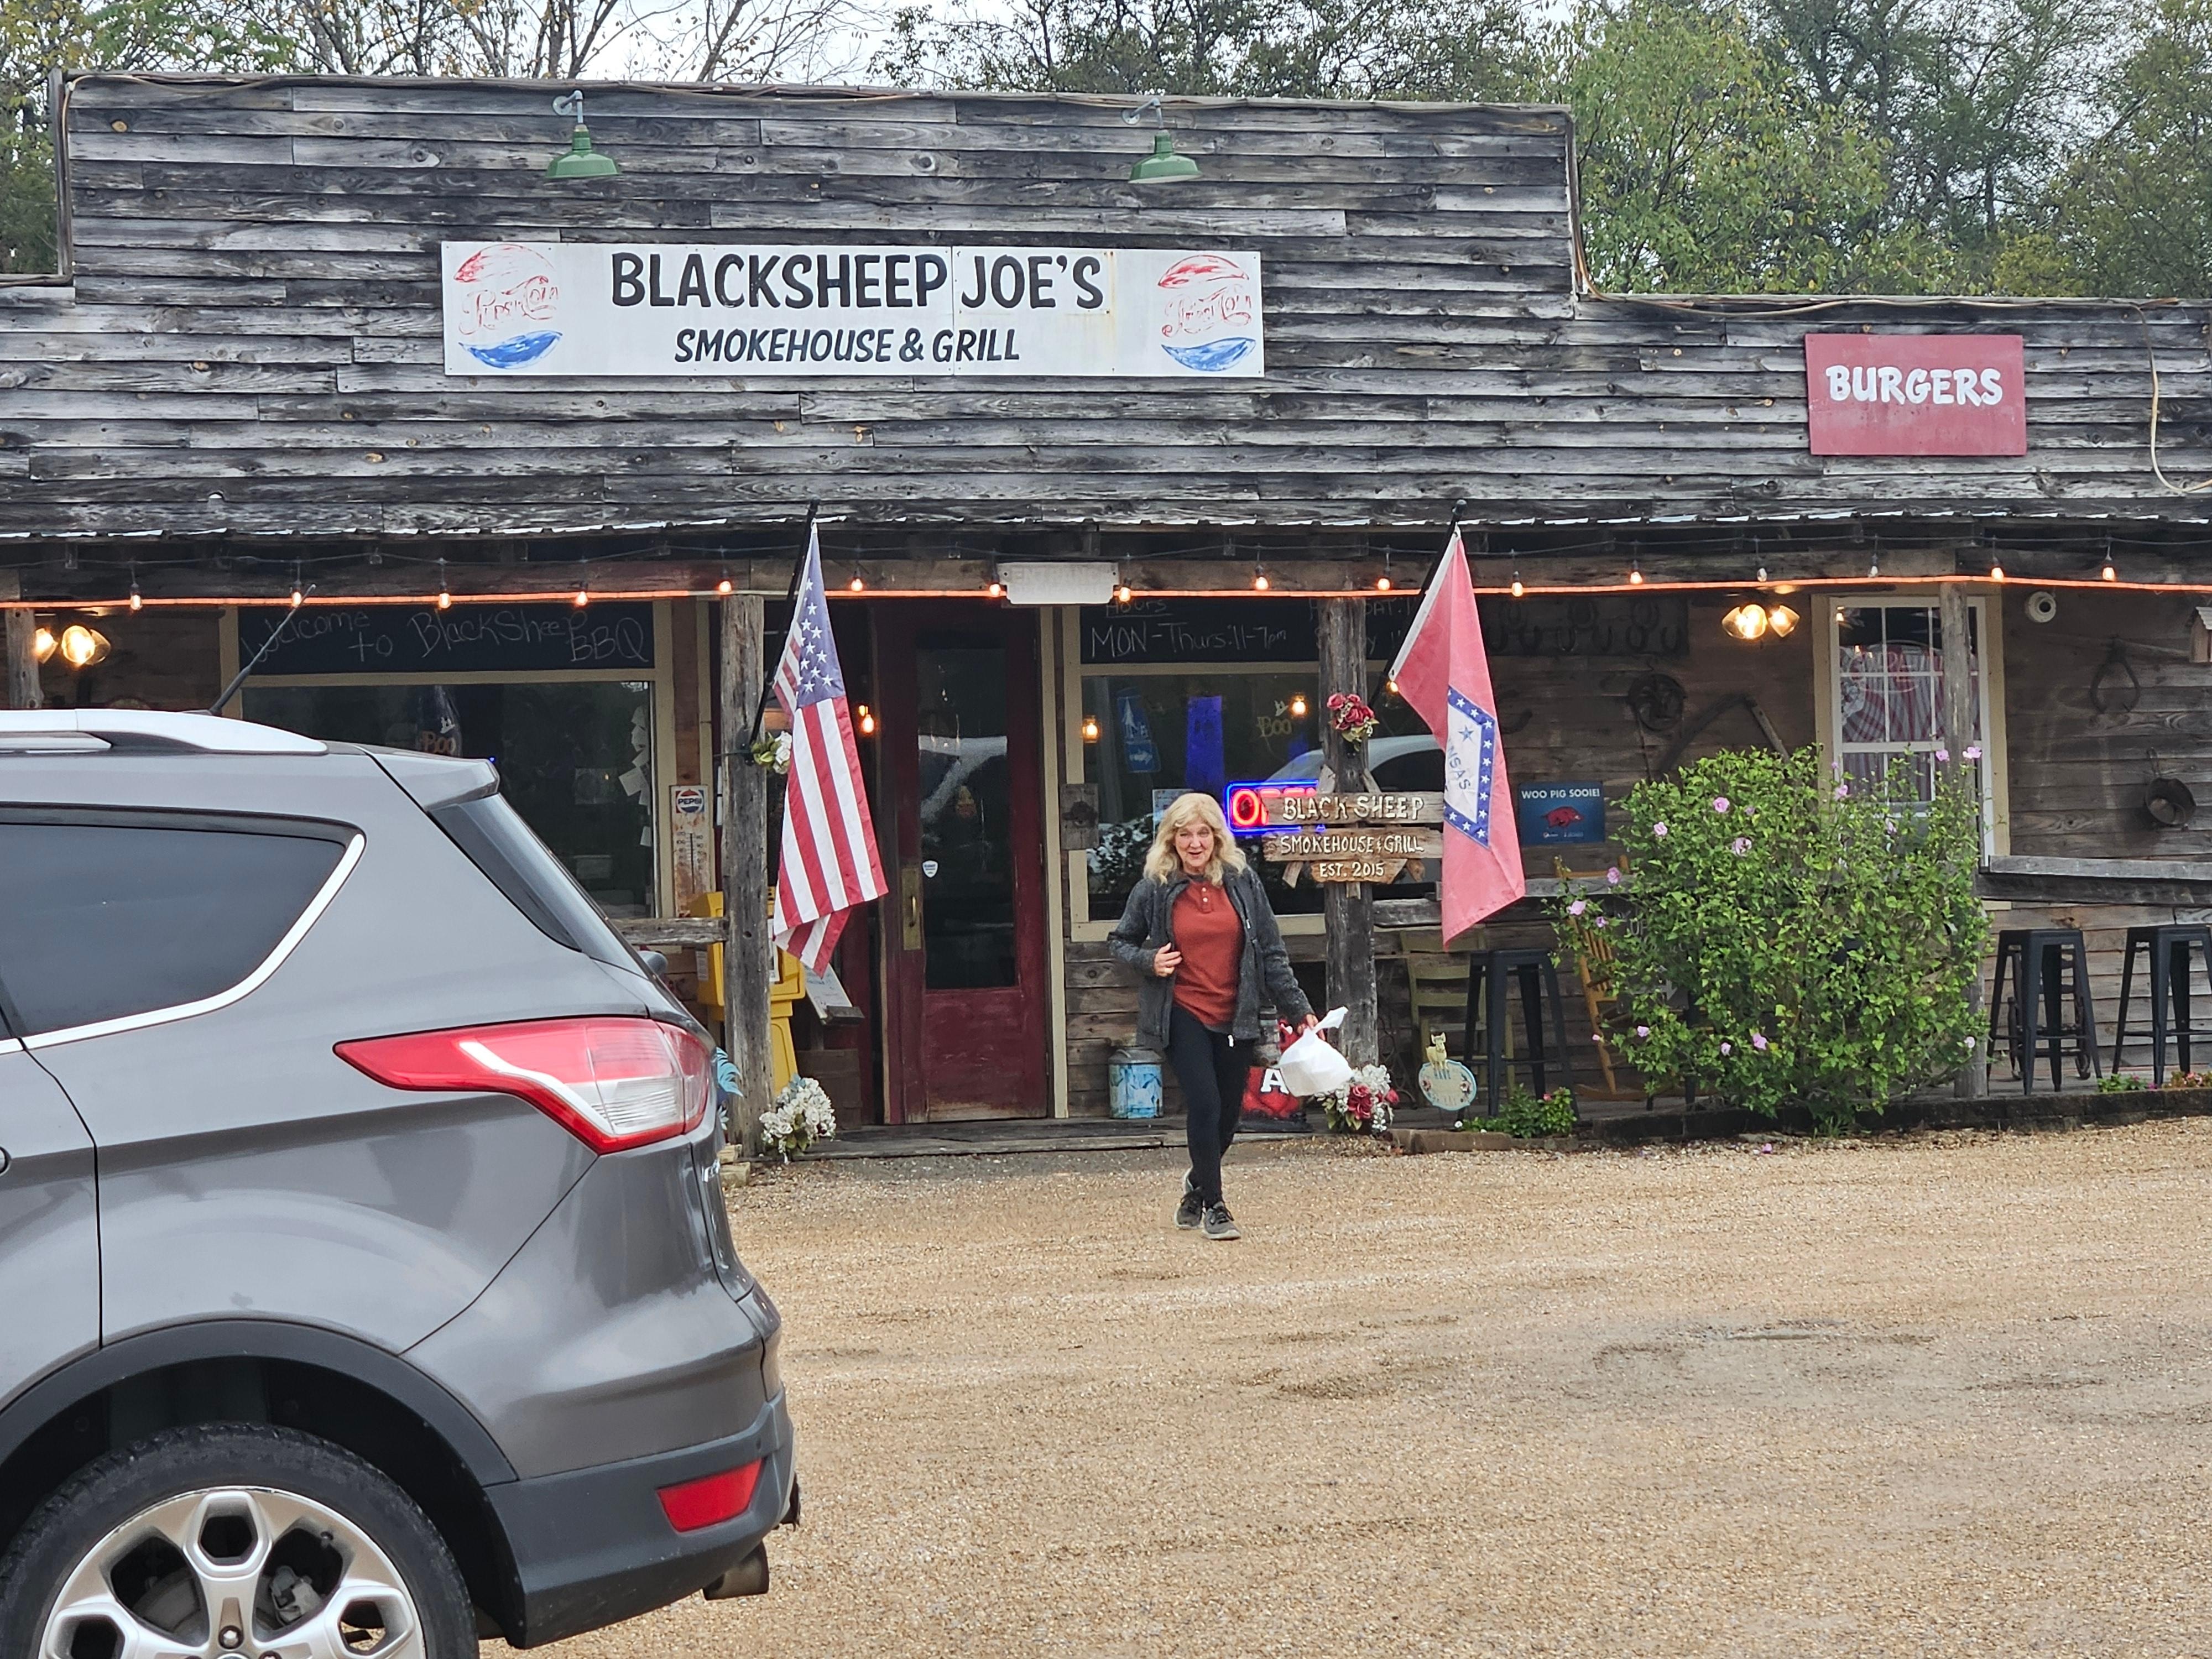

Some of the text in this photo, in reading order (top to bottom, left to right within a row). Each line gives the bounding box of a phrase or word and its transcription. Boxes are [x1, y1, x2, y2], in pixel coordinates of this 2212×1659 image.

[612, 252, 1104, 309] BLACKSHEEP JOE'S
[674, 327, 1020, 363] SMOKEHOUSE & GRILL
[1825, 365, 2003, 407] BURGERS
[241, 611, 371, 663] Welcome
[567, 617, 650, 662] BBQ
[1282, 796, 1348, 821] BLACK
[1354, 795, 1425, 821] SHEEP
[1521, 787, 1600, 800] WOO PIG SOOIE!
[1280, 836, 1375, 855] SMOKEHOUSE
[1383, 836, 1425, 854] GRILL
[1319, 861, 1385, 878] EST. 2015
